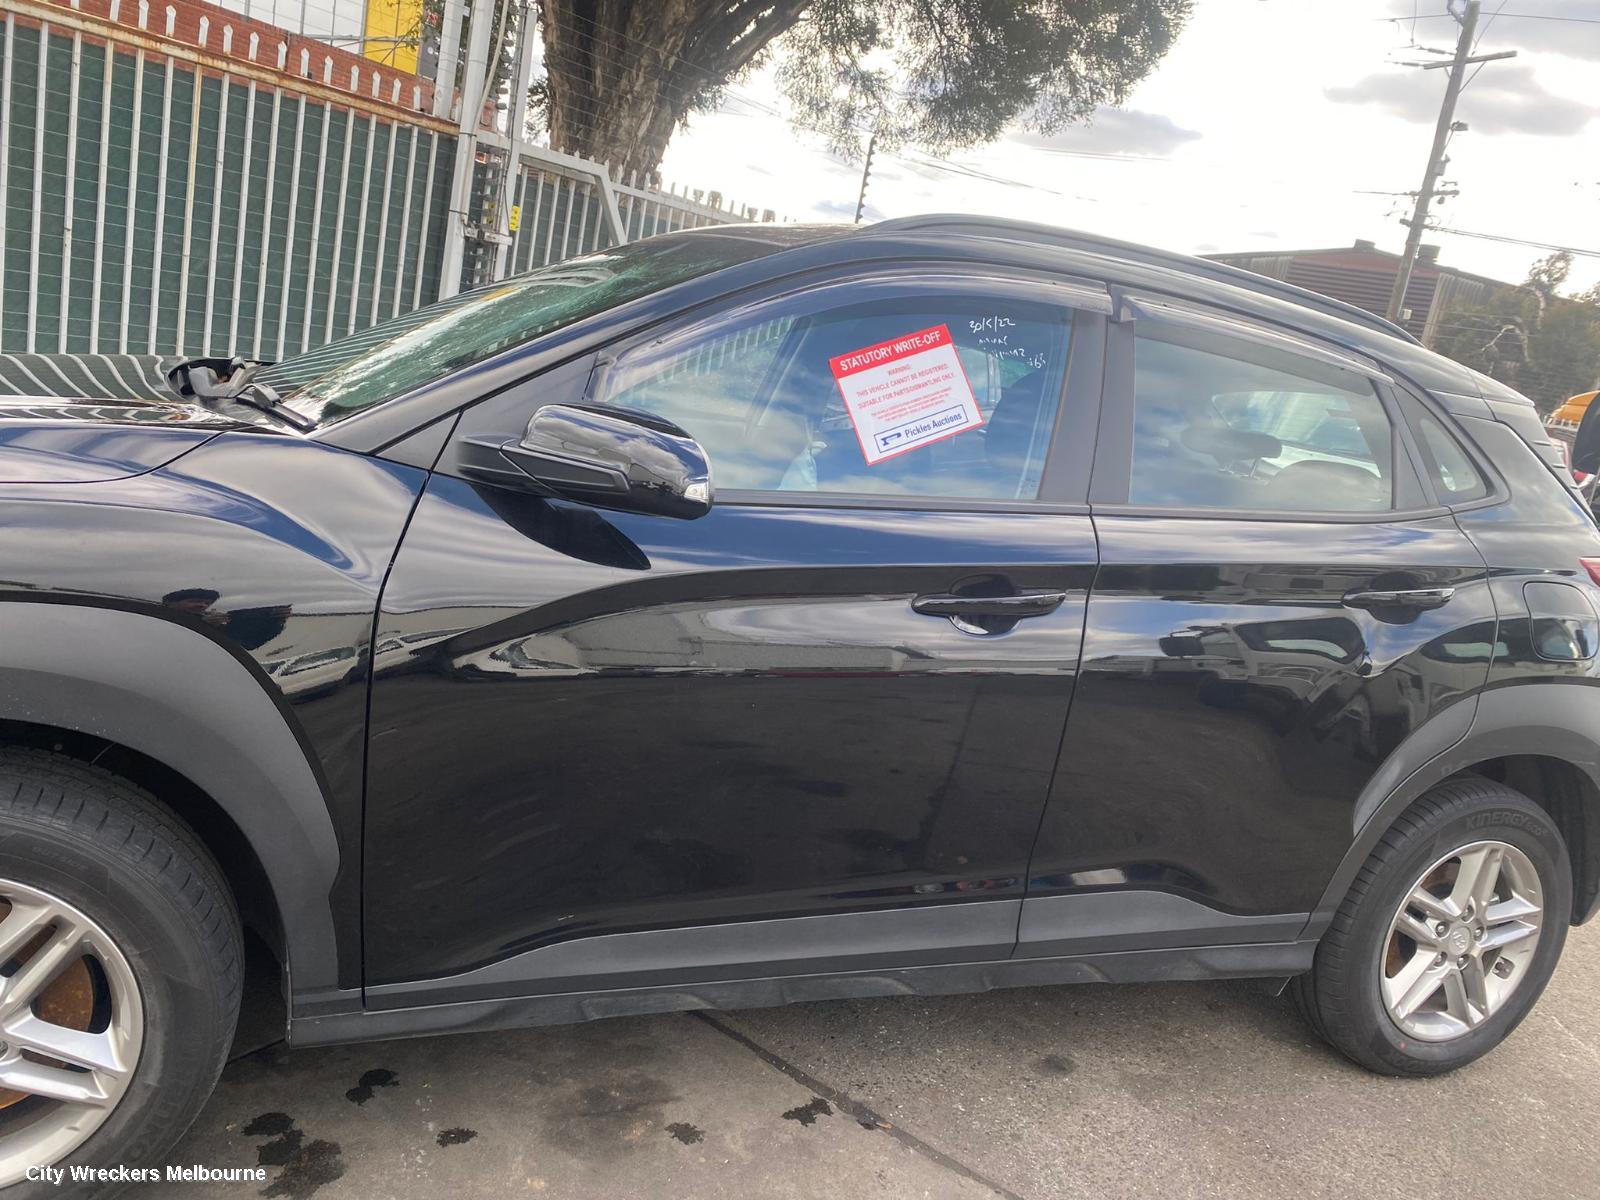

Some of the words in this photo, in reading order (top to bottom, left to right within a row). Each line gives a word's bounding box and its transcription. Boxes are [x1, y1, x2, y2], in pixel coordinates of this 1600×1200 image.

[840, 348, 893, 372] STATUTORY
[894, 331, 942, 353] WRITE-OFF
[857, 389, 869, 397] THIS
[869, 383, 889, 395] VEHICLE
[890, 376, 911, 389] CANNOT
[911, 373, 918, 381] BE
[858, 397, 882, 409] SUITABLE
[883, 394, 893, 402] FOR
[905, 422, 932, 438] Pickles
[932, 412, 962, 429] Auctions
[1466, 811, 1528, 831] KINERGY
